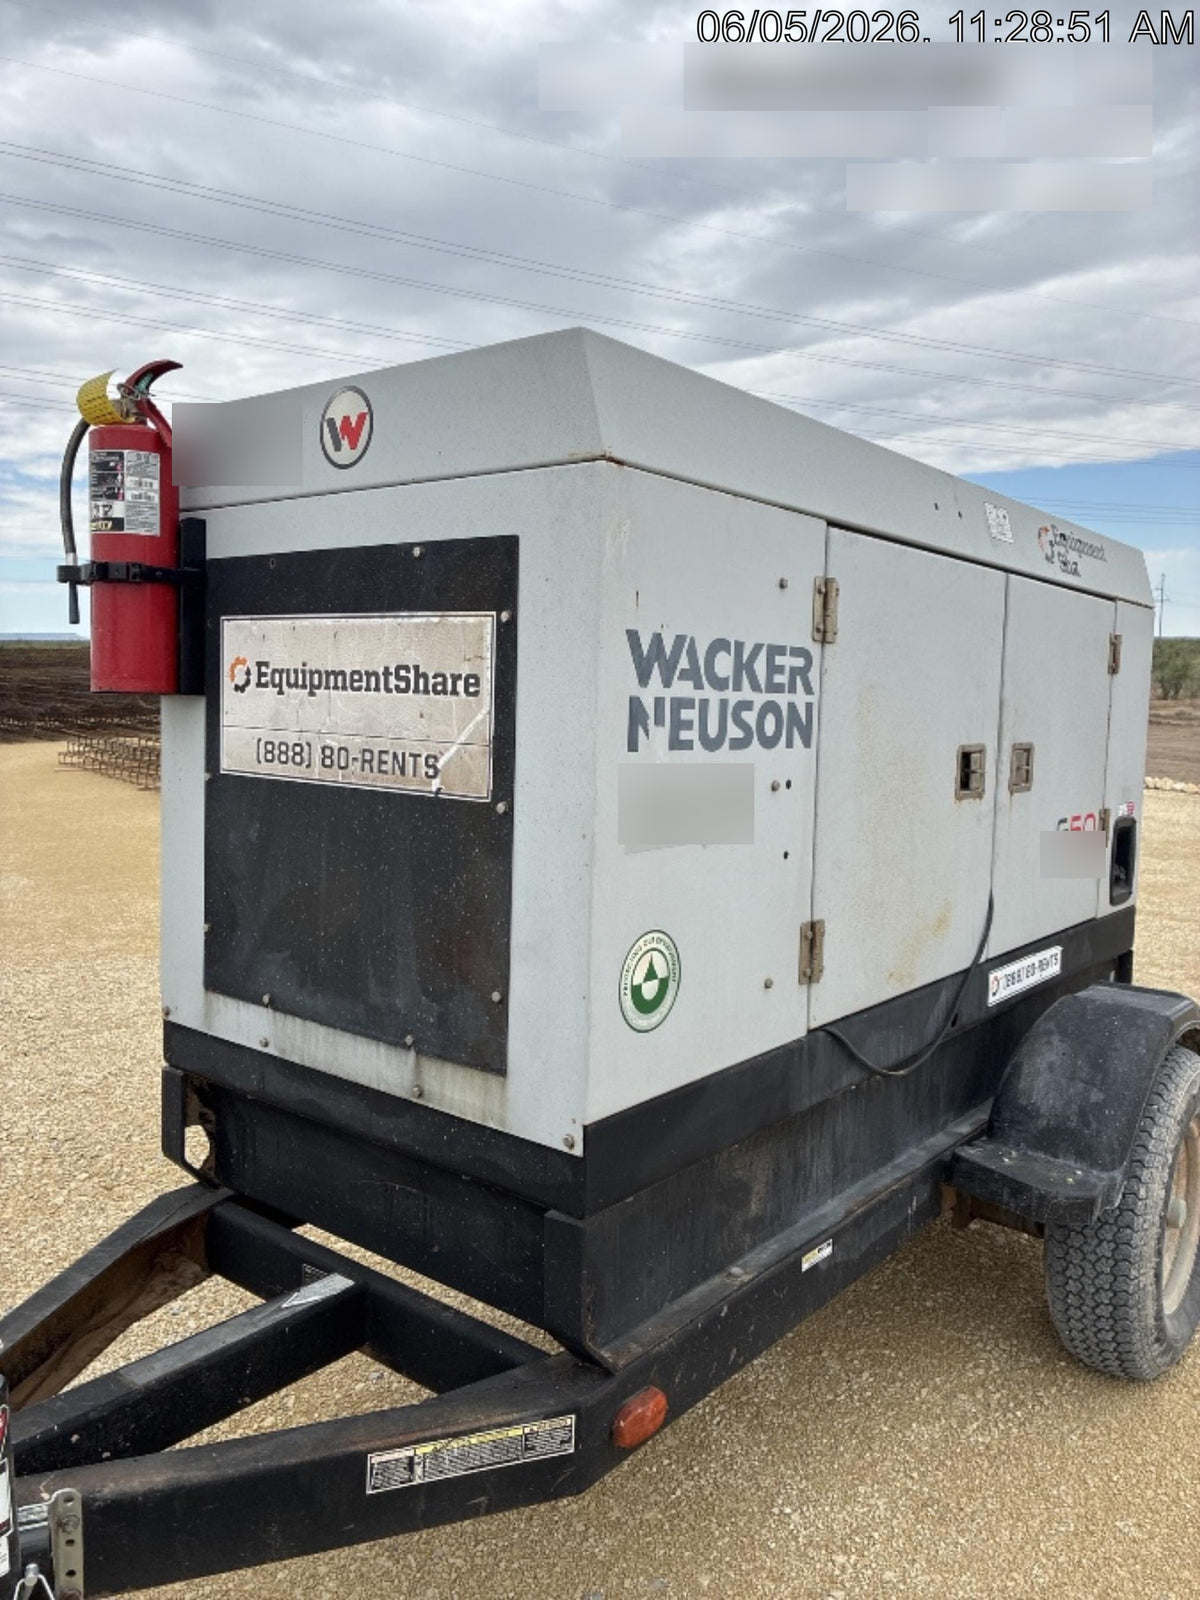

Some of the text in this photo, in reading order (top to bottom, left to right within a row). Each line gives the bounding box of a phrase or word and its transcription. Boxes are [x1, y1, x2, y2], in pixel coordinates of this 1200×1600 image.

[254, 660, 481, 698] EquipmentShare
[625, 629, 815, 695] WACKER
[627, 695, 814, 753] NEUSON
[256, 737, 441, 780] (888) 80-RENTS
